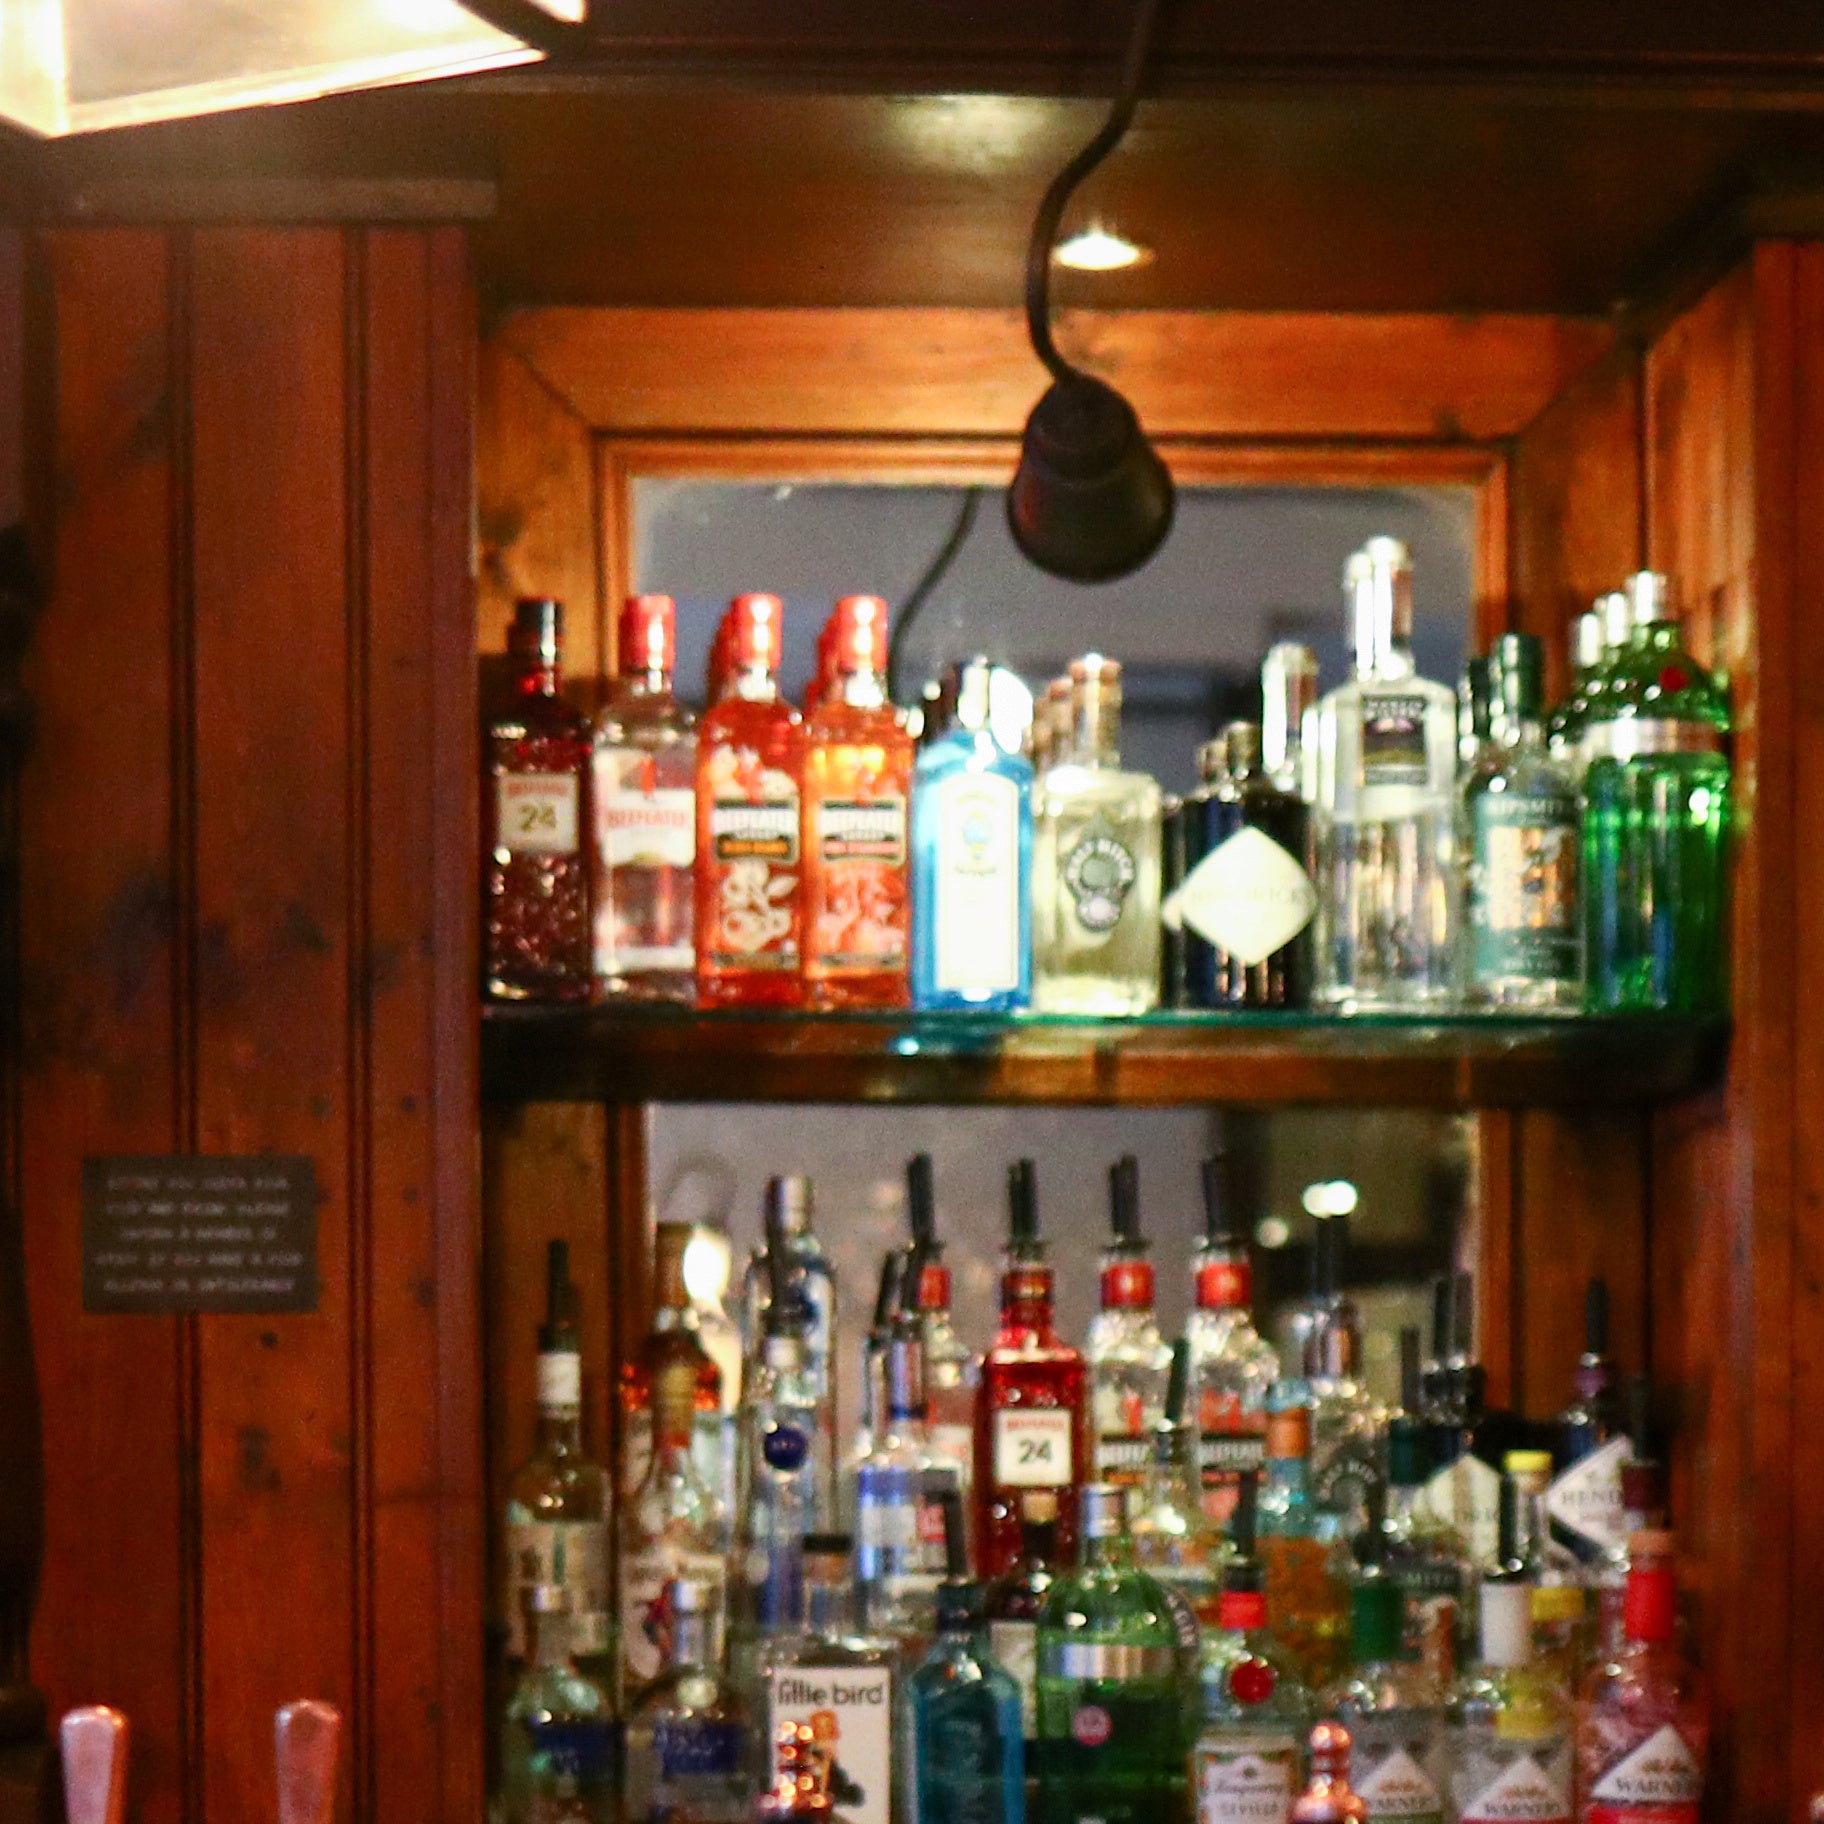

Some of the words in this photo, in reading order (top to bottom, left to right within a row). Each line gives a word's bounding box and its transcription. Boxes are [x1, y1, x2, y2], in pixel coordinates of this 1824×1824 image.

[519, 804, 558, 833] 24
[1018, 1438, 1054, 1466] 24
[831, 1679, 884, 1706] bird
